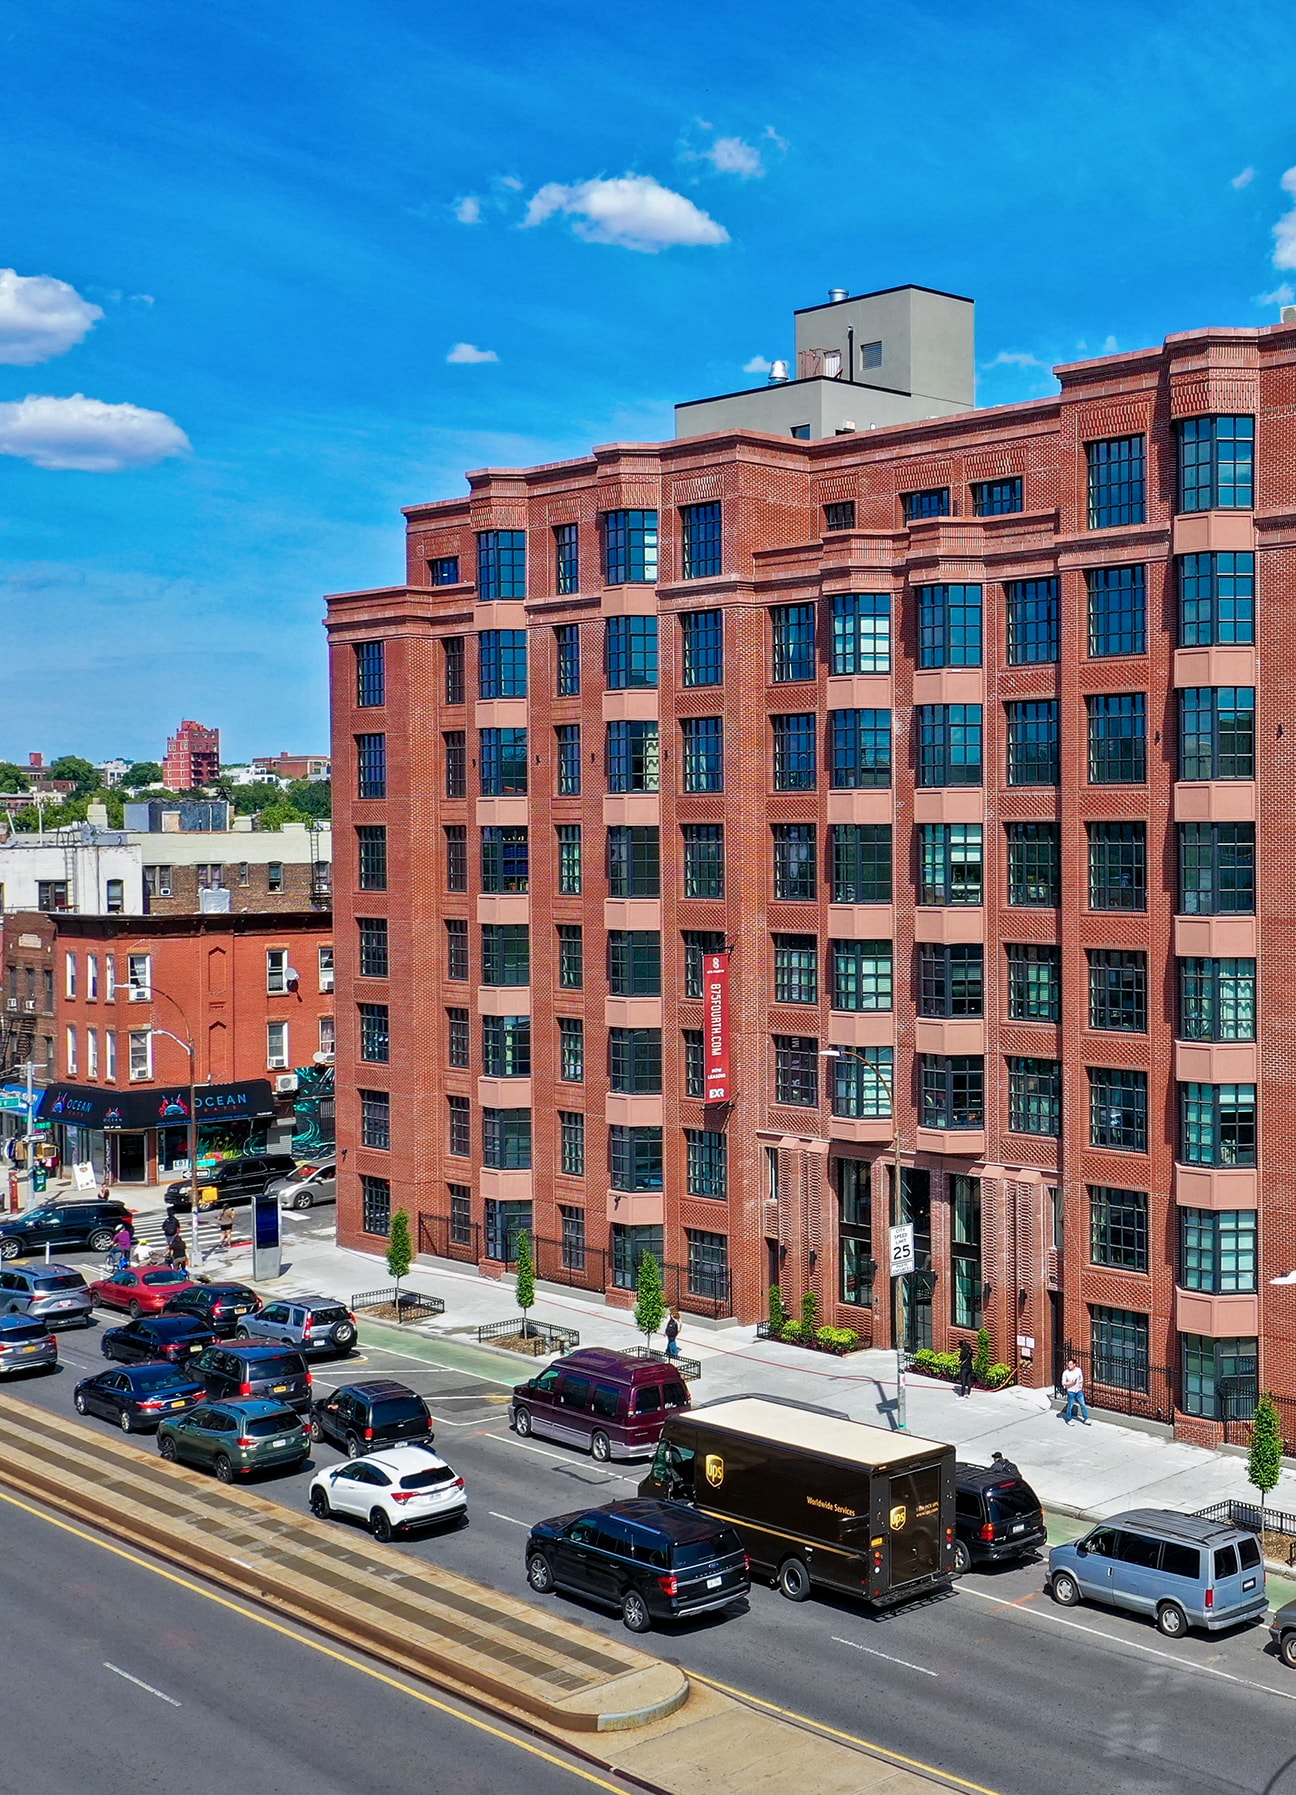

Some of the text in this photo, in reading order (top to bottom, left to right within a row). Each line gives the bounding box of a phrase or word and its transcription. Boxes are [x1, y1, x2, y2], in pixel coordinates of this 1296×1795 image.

[710, 983, 722, 1056] 875FOURTH.COM
[66, 1099, 92, 1113] OCEAN
[194, 1094, 247, 1108] OCEAN
[893, 1245, 911, 1260] 25
[707, 1463, 723, 1482] ups
[806, 1495, 856, 1517] Worldwide Services
